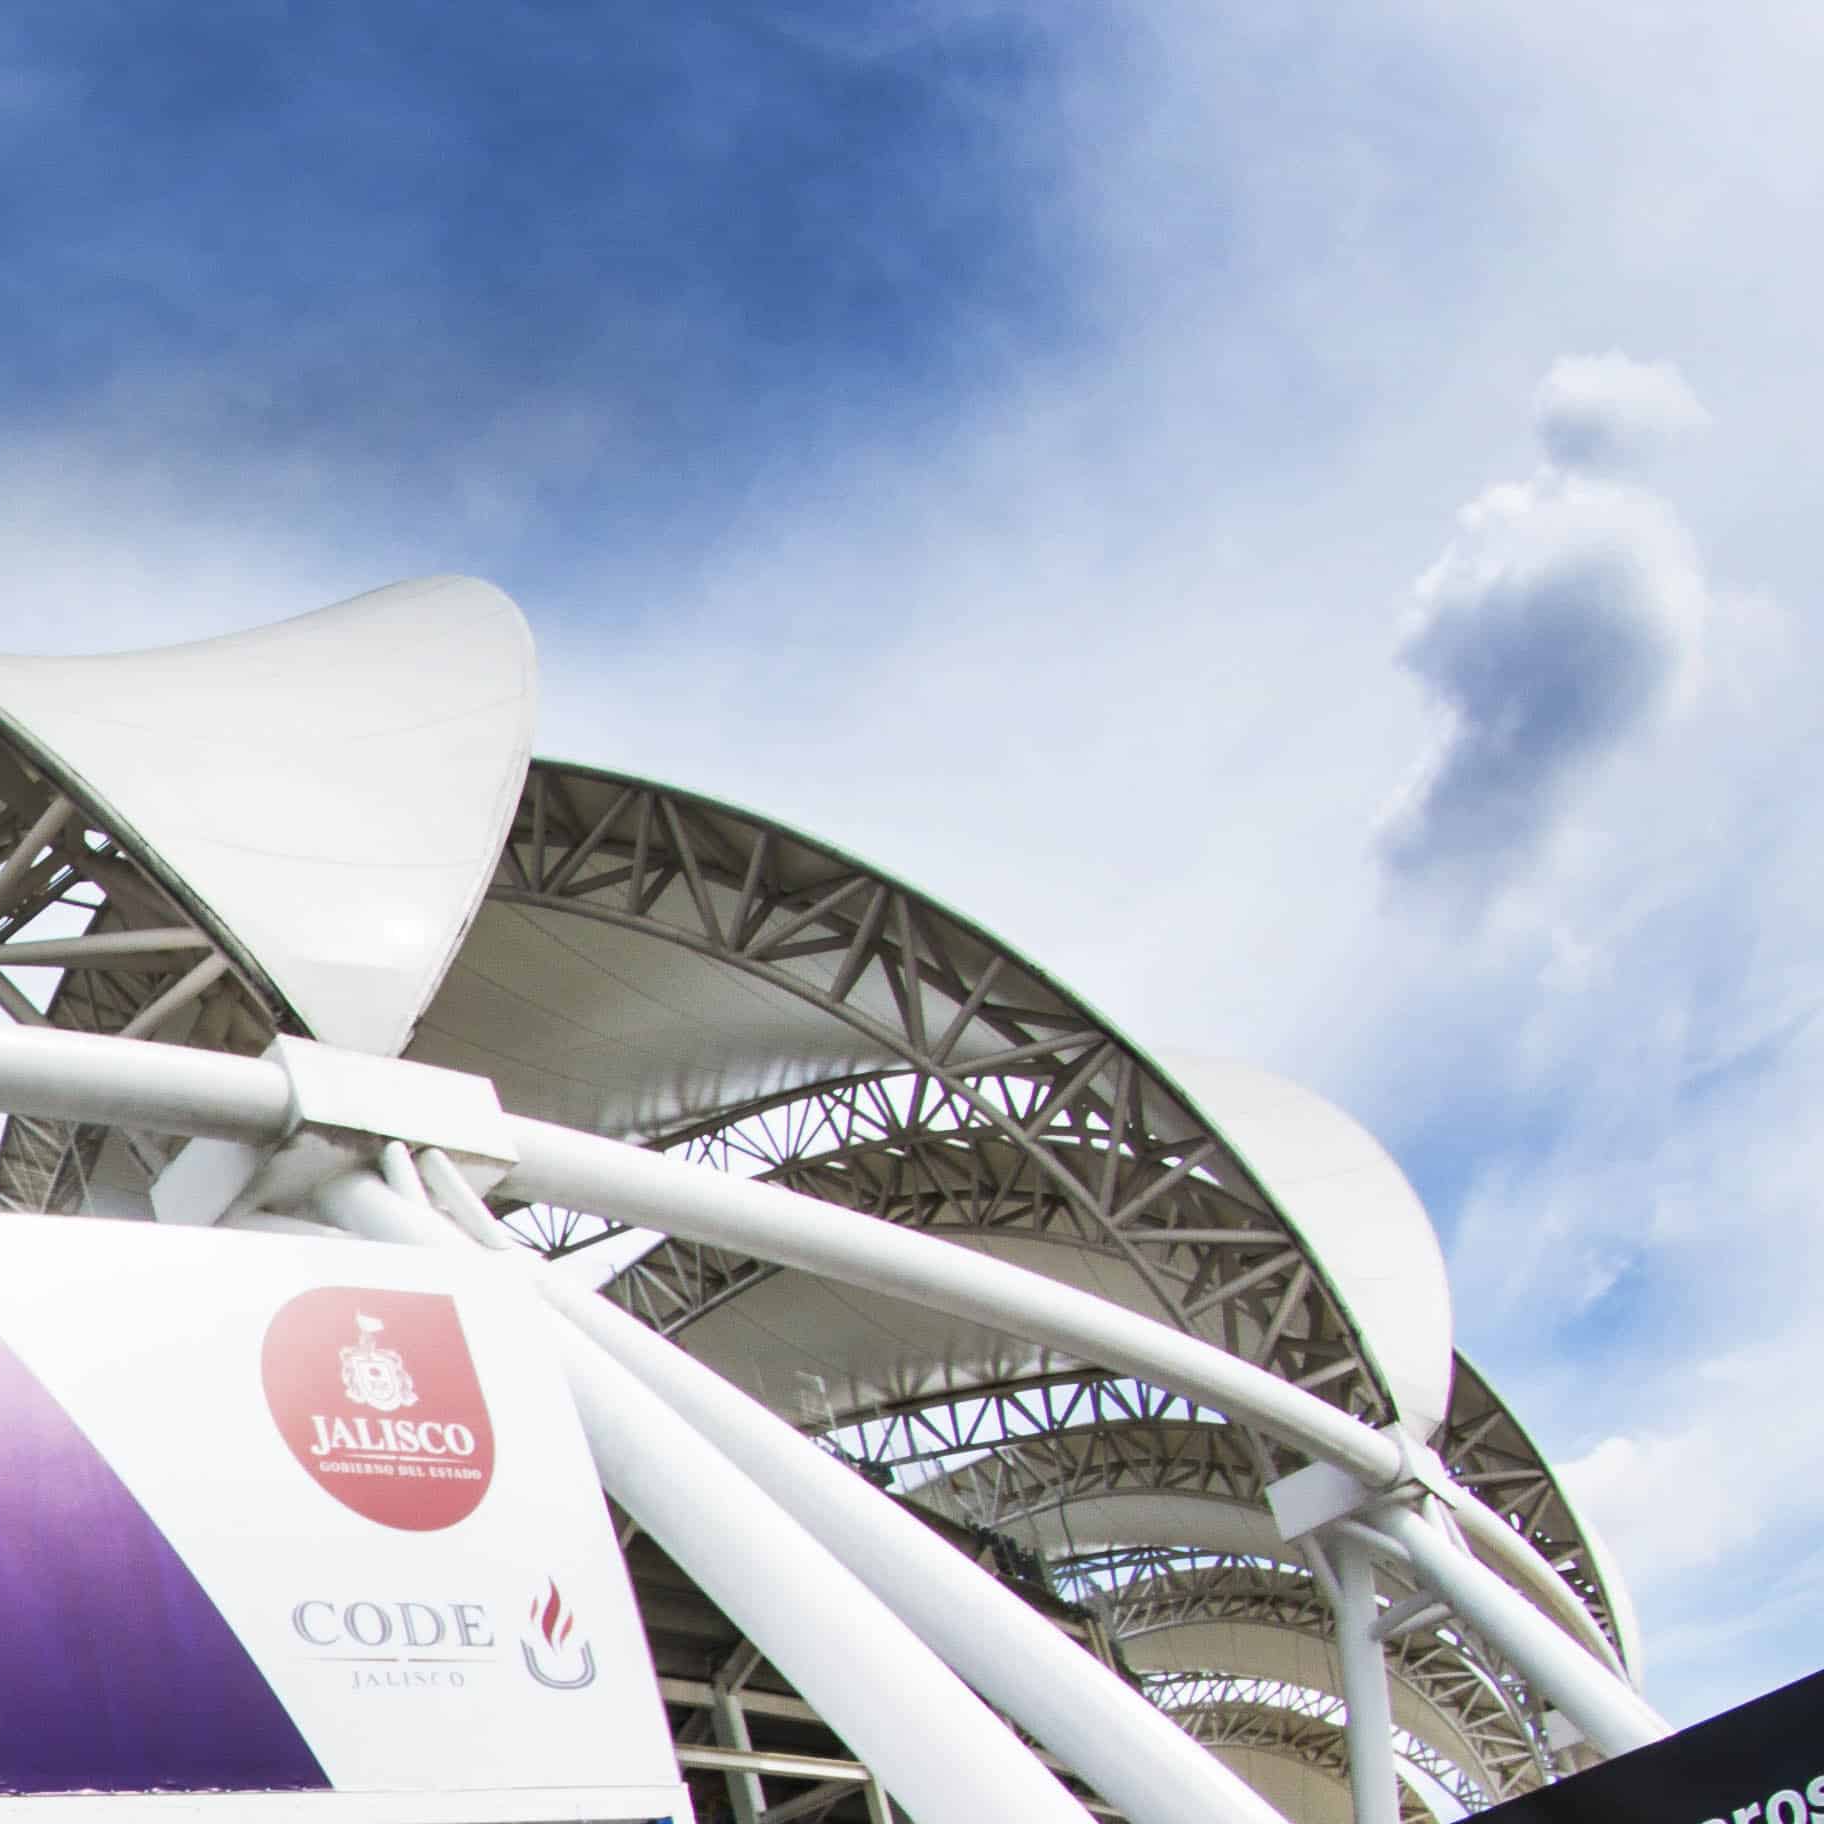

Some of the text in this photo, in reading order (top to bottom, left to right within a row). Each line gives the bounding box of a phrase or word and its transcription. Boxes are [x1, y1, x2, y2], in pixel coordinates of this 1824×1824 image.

[310, 1414, 475, 1456] JALISCO
[319, 1461, 481, 1481] GOBIERNO DEL ESTADO
[291, 1600, 496, 1648] CODE
